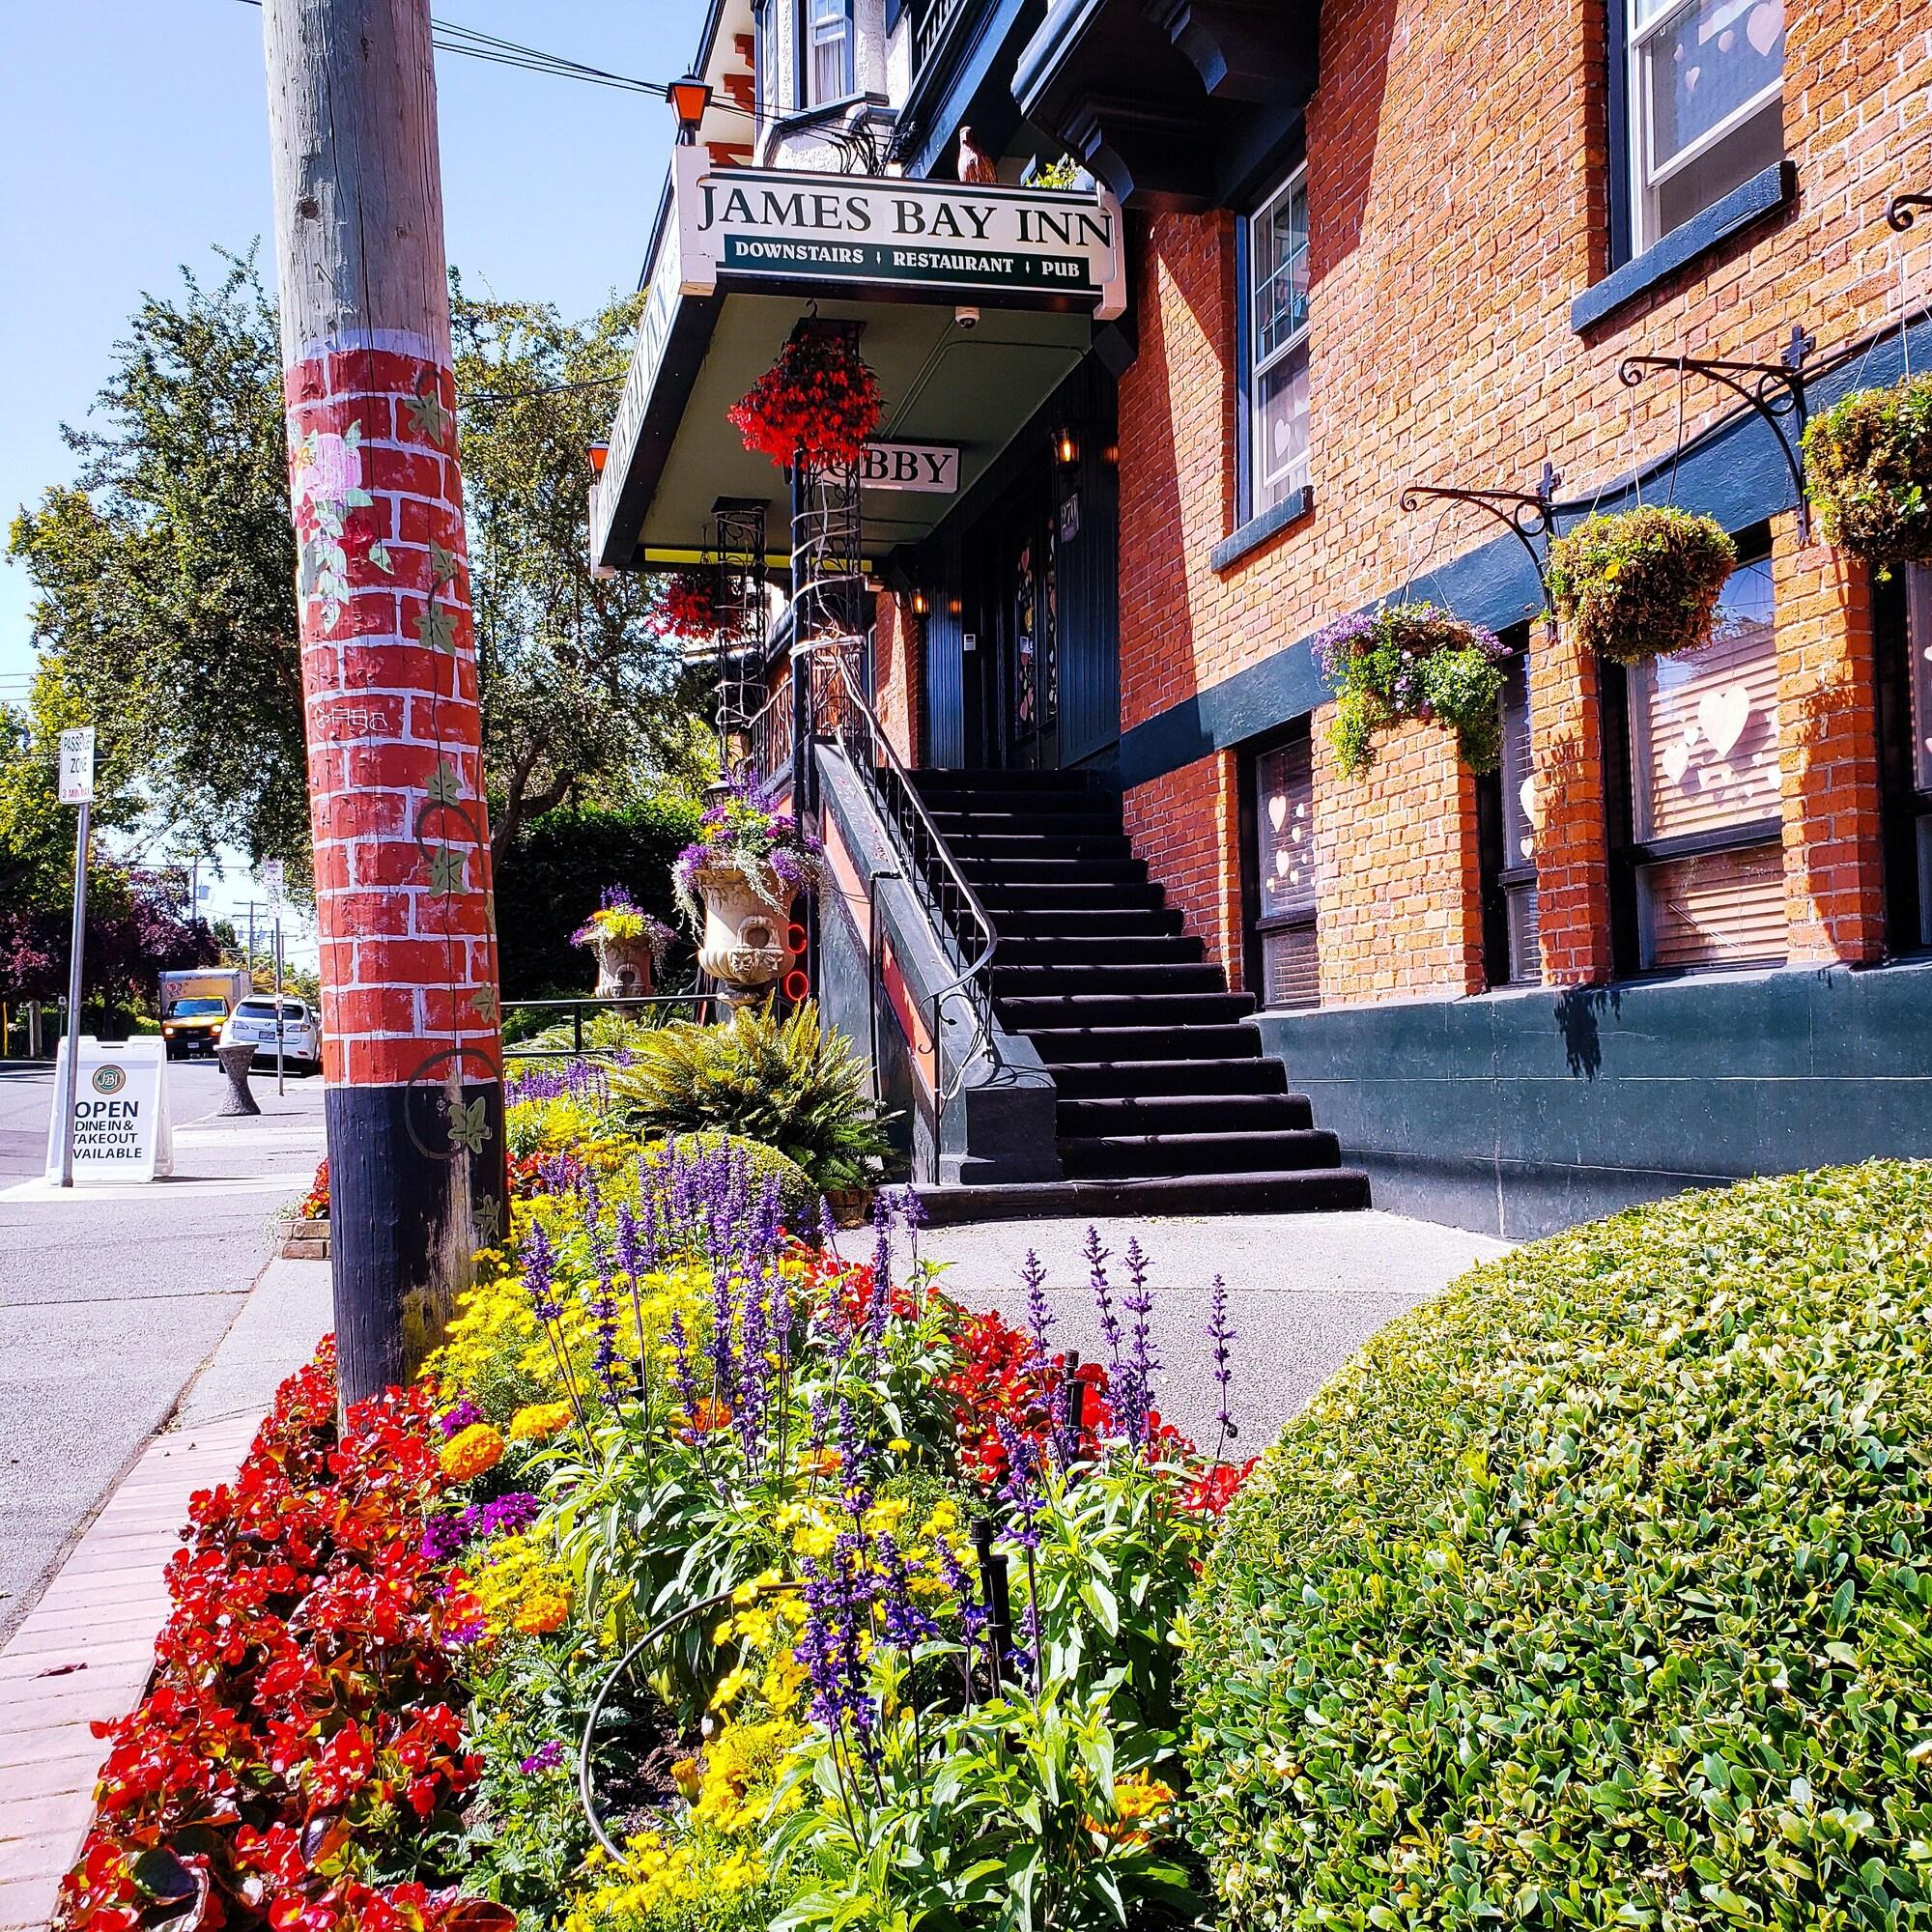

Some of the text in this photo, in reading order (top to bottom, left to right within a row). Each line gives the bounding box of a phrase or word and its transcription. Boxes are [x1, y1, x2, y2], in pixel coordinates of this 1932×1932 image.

[697, 185, 1114, 248] JAMES BAY INN
[734, 241, 1080, 277] DOWNSTAIRS RESTAURANT PUB
[828, 449, 952, 483] BBY
[74, 1100, 139, 1119] OPEN
[74, 1120, 134, 1131] DINE IN &
[72, 1148, 143, 1159] VAILABLE
